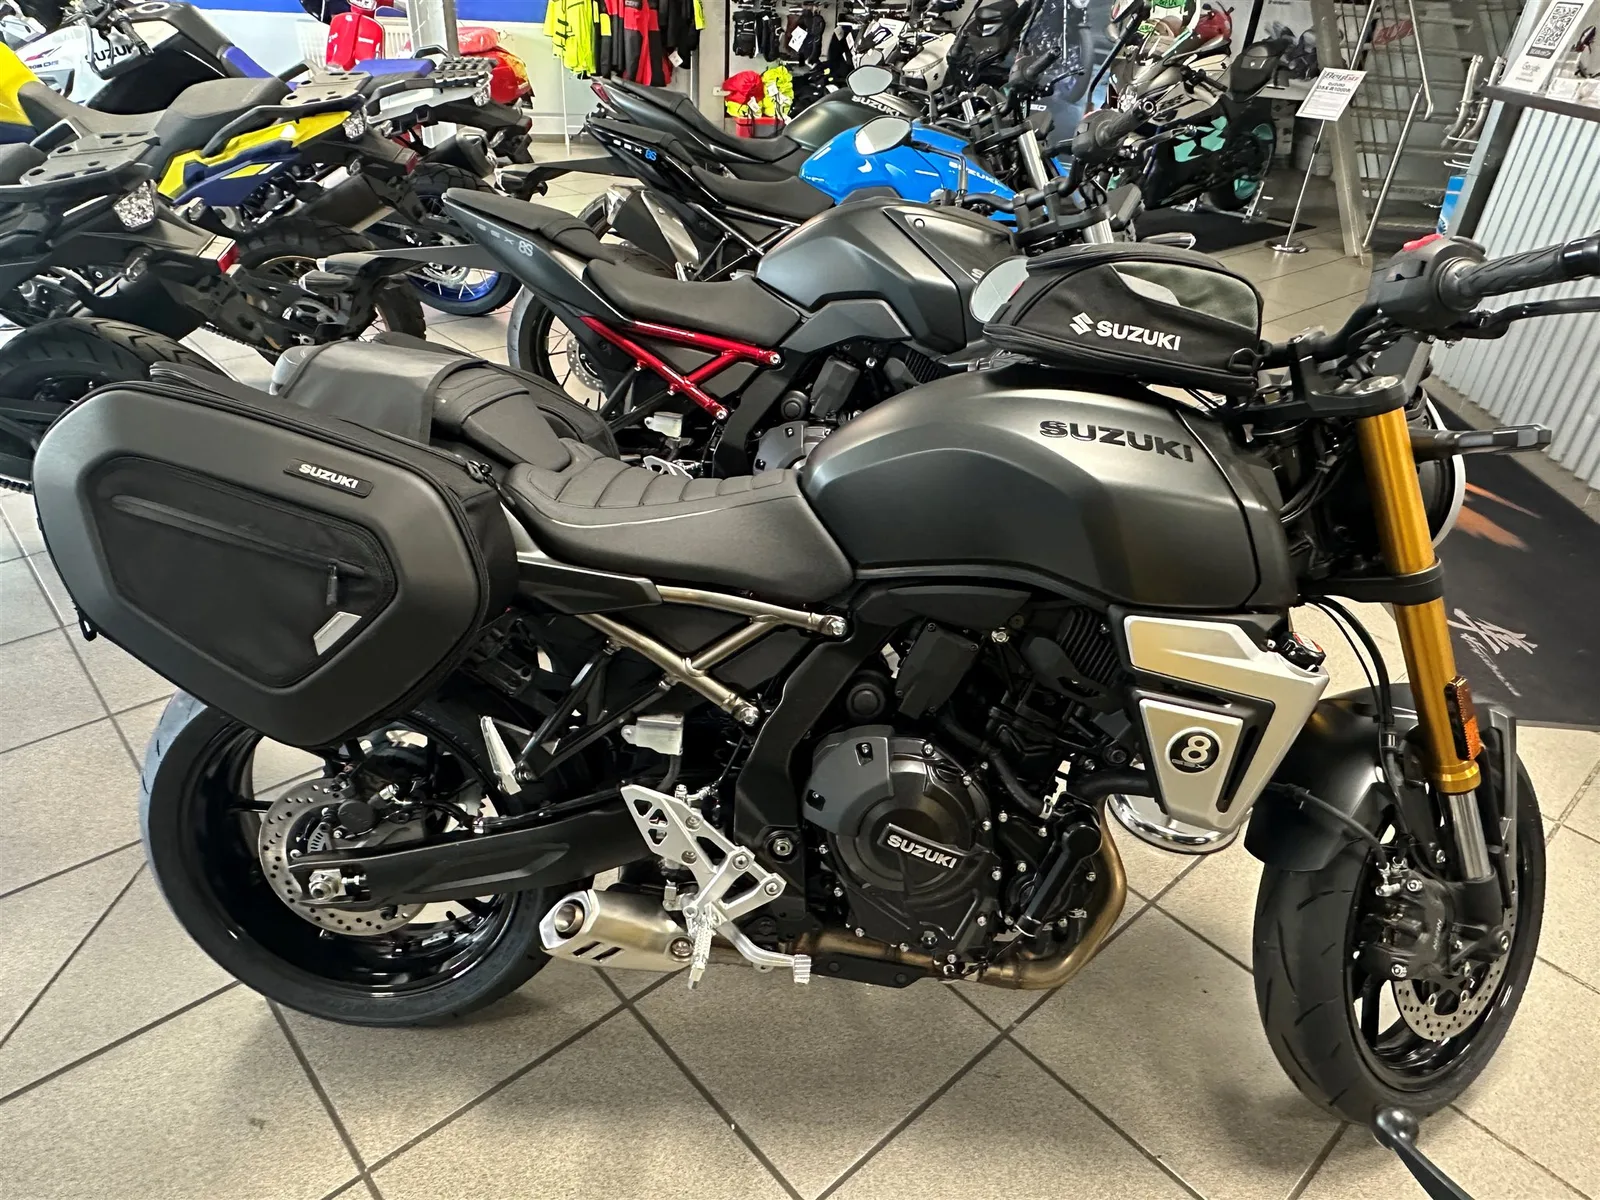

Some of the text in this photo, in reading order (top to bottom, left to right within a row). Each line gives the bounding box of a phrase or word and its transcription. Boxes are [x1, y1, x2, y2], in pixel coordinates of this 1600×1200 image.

[518, 240, 534, 257] 8S
[1095, 320, 1181, 351] SUZUKI
[1039, 420, 1194, 463] SUZUKI
[298, 463, 359, 489] SUZUKI
[1180, 735, 1212, 763] 8
[887, 834, 957, 869] SUZUKI
